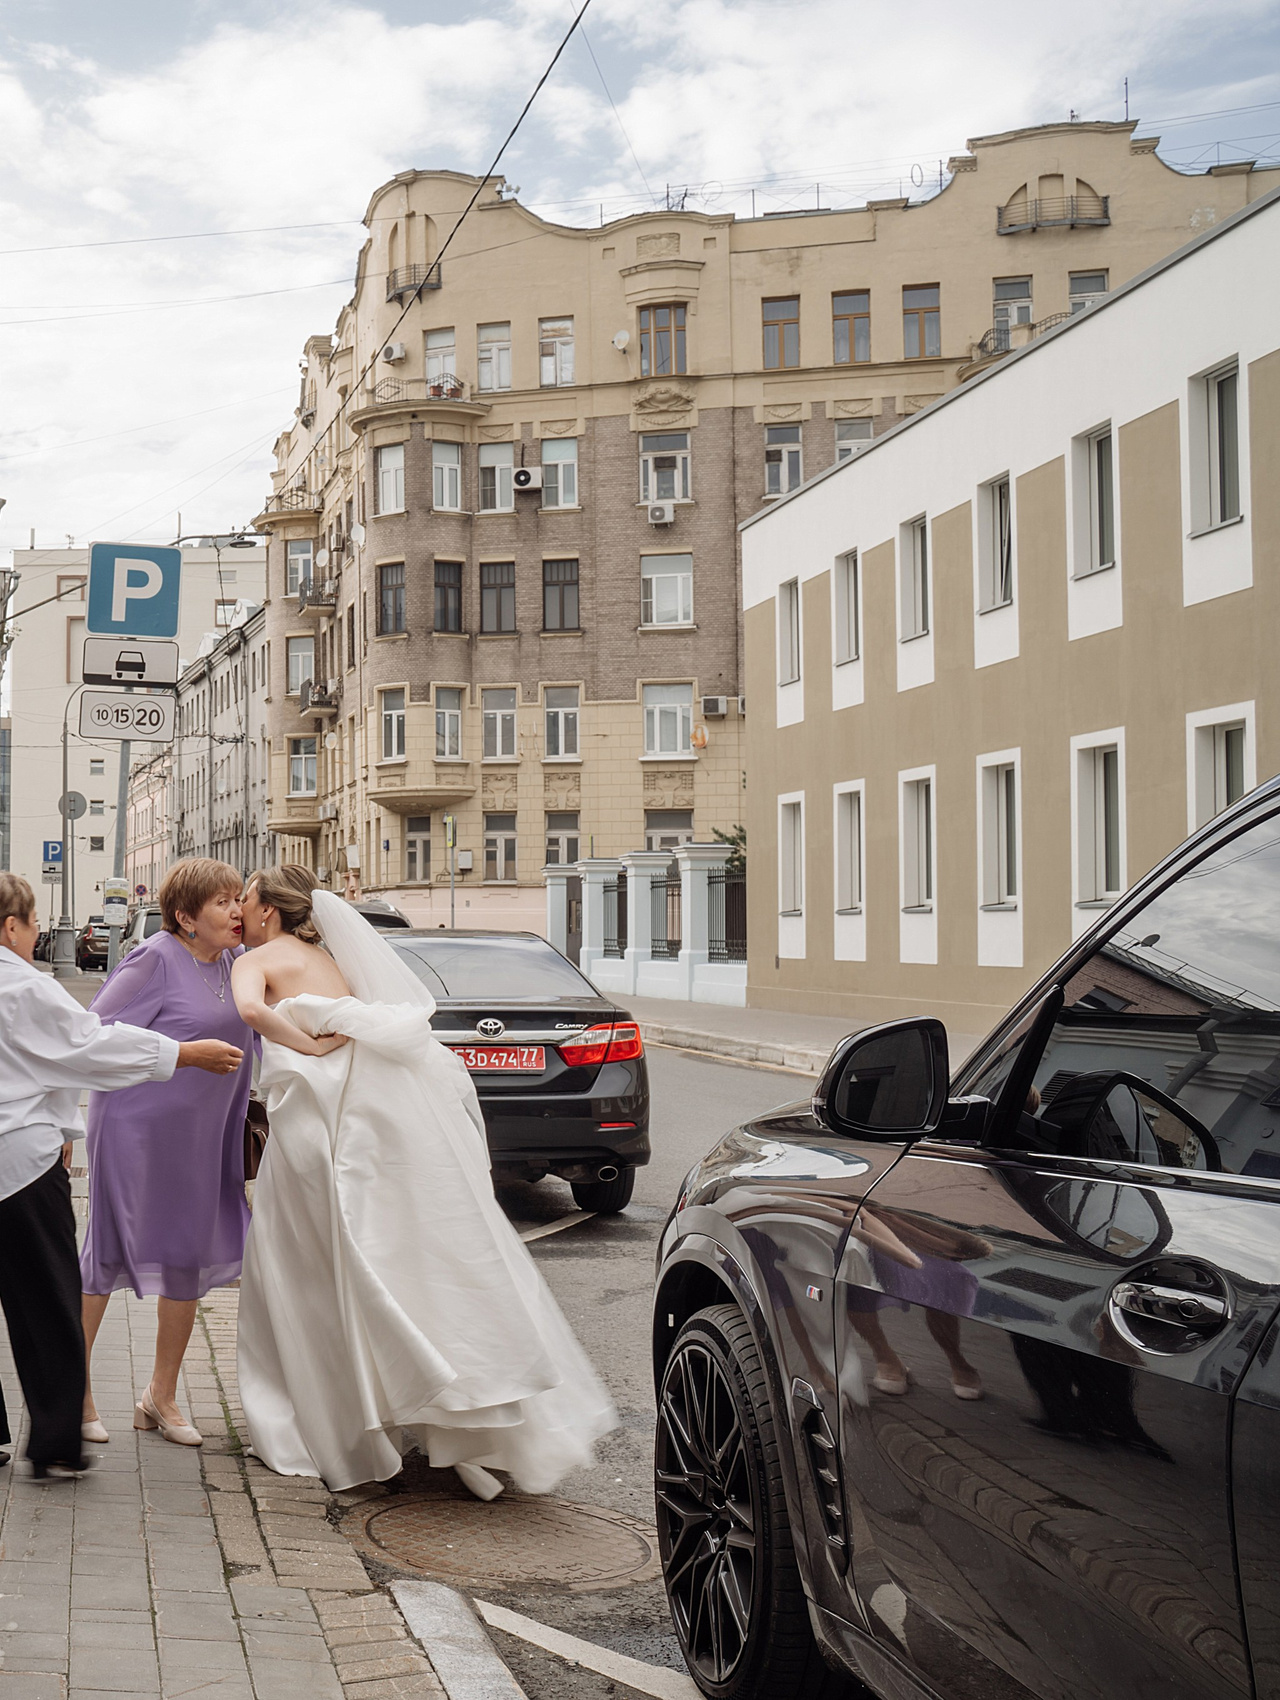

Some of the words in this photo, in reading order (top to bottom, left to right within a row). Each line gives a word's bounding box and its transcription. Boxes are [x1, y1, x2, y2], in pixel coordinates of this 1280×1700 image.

[111, 557, 163, 622] P
[96, 709, 109, 721] 10
[114, 708, 129, 723] 15
[135, 708, 160, 726] 20
[48, 842, 61, 860] P
[453, 1048, 518, 1067] 53D474
[520, 1048, 538, 1061] 77
